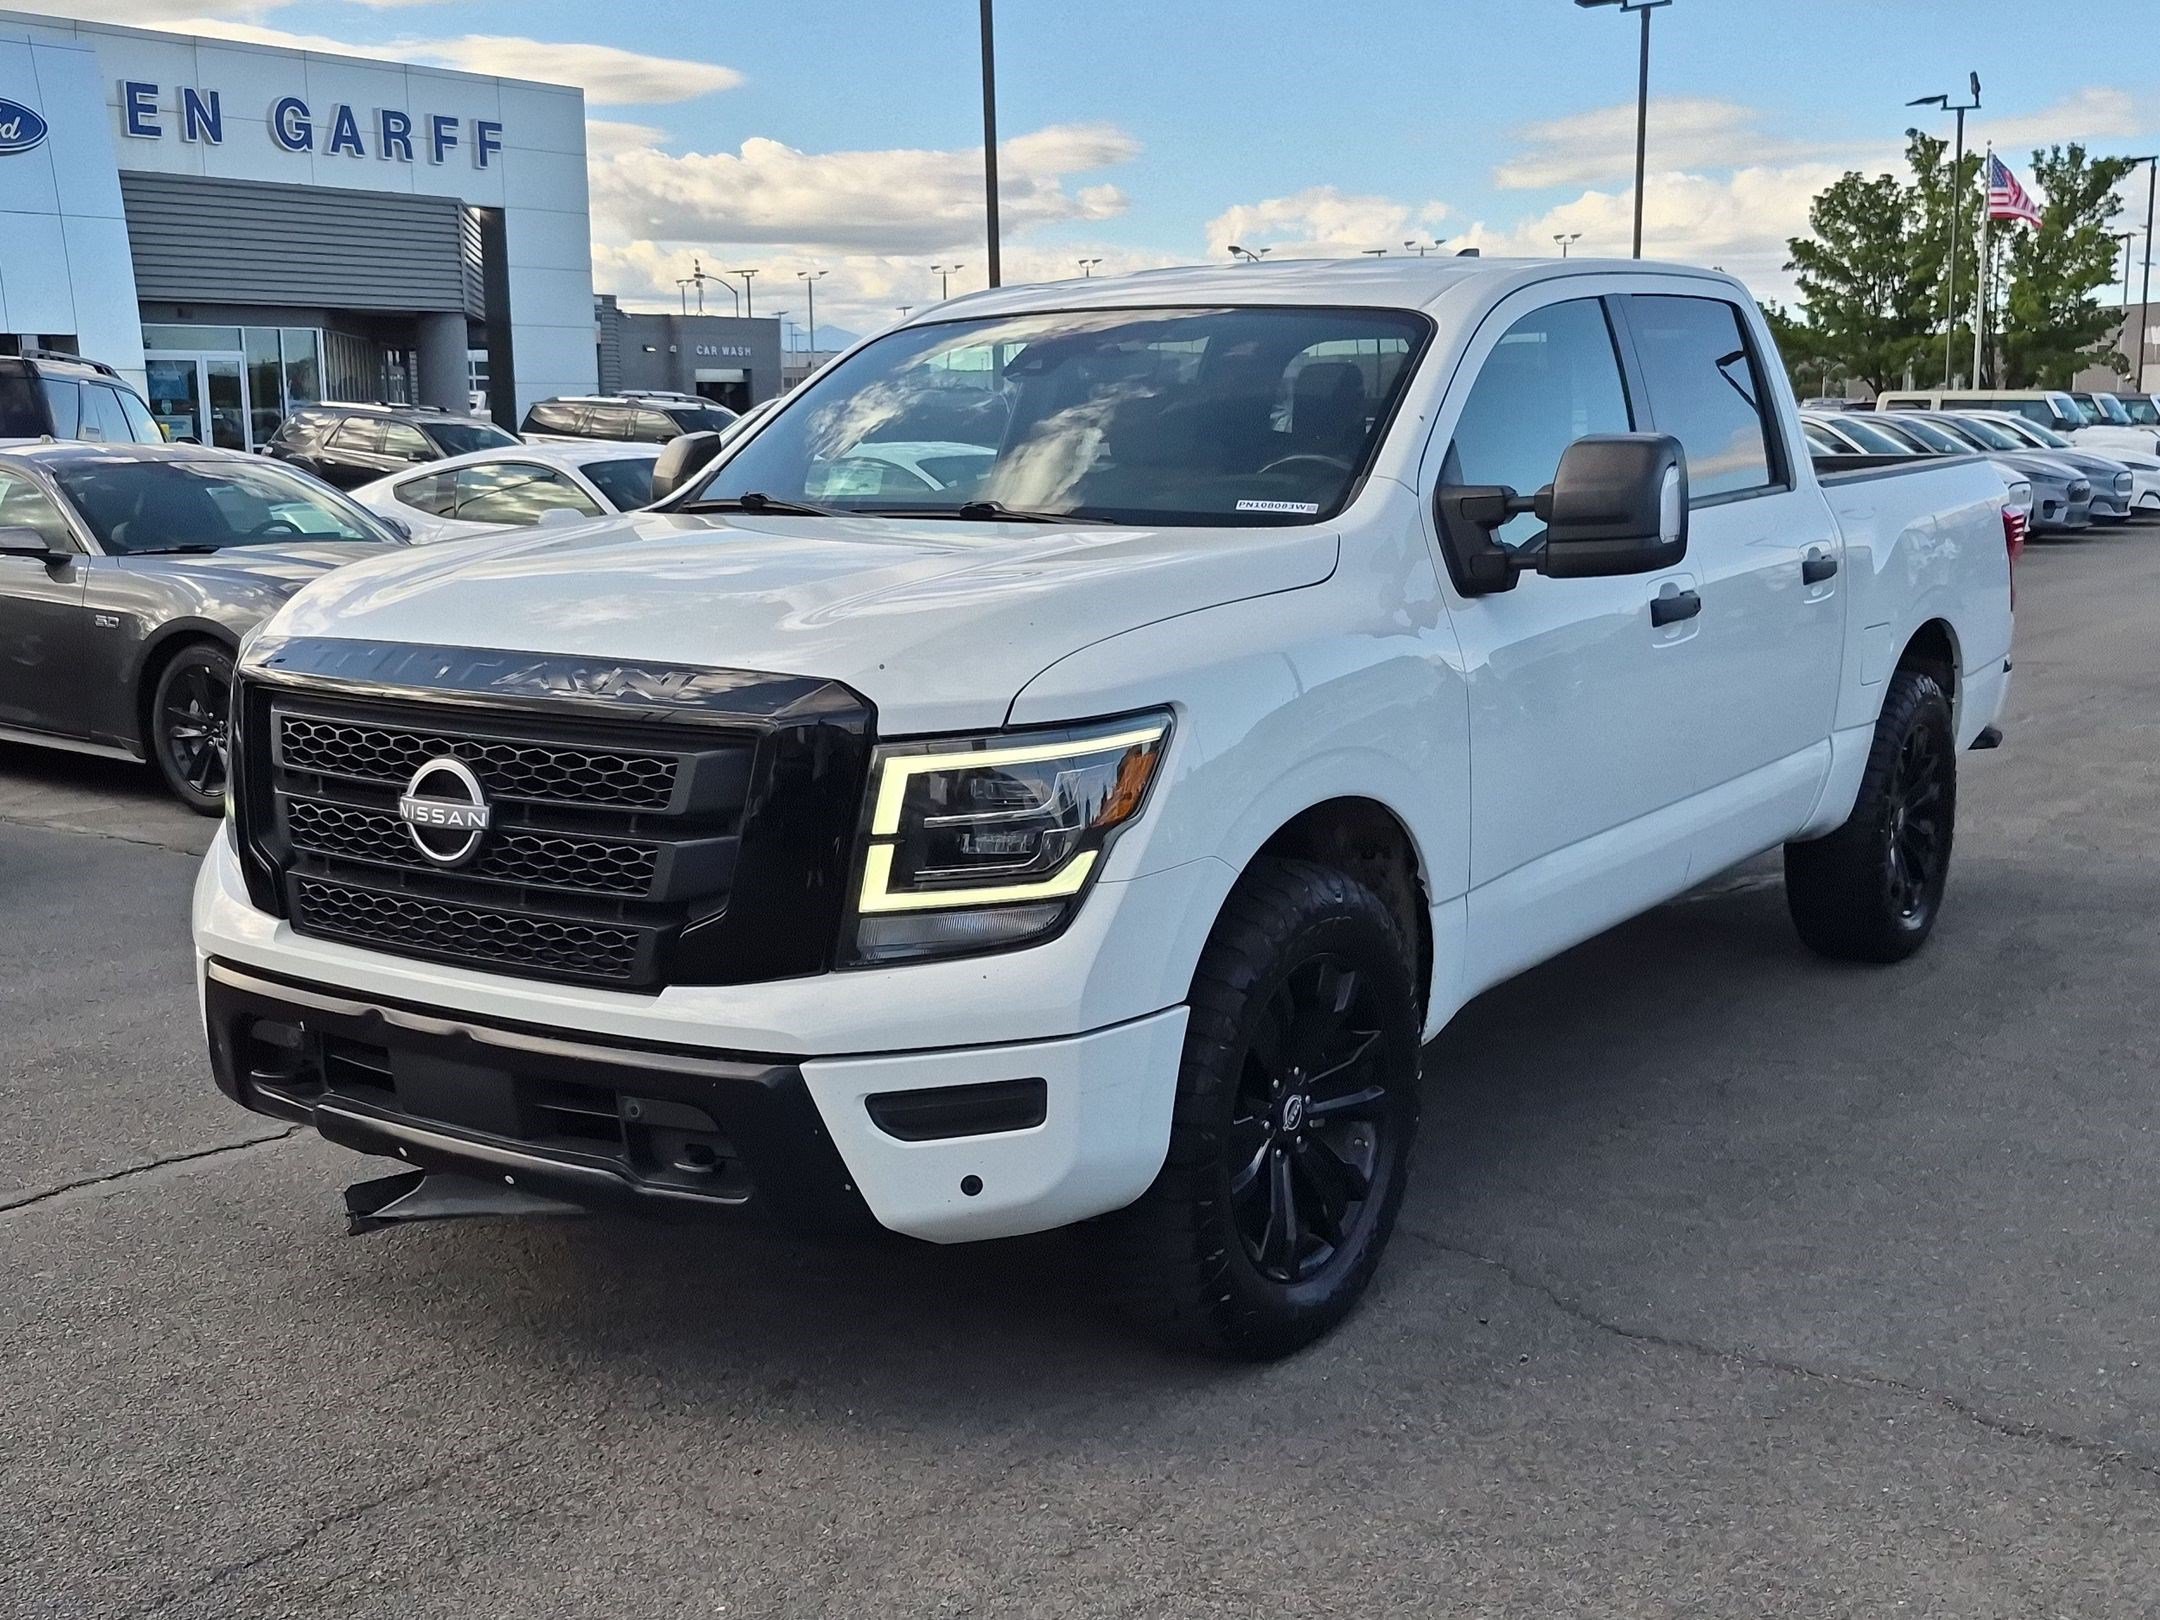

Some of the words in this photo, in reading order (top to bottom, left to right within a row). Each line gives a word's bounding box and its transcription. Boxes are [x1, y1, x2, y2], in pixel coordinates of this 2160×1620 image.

[268, 95, 503, 170] GARFF
[696, 345, 718, 356] CAR
[721, 345, 752, 357] WASH
[312, 643, 699, 702] TITAN
[400, 801, 486, 828] NISSAN
